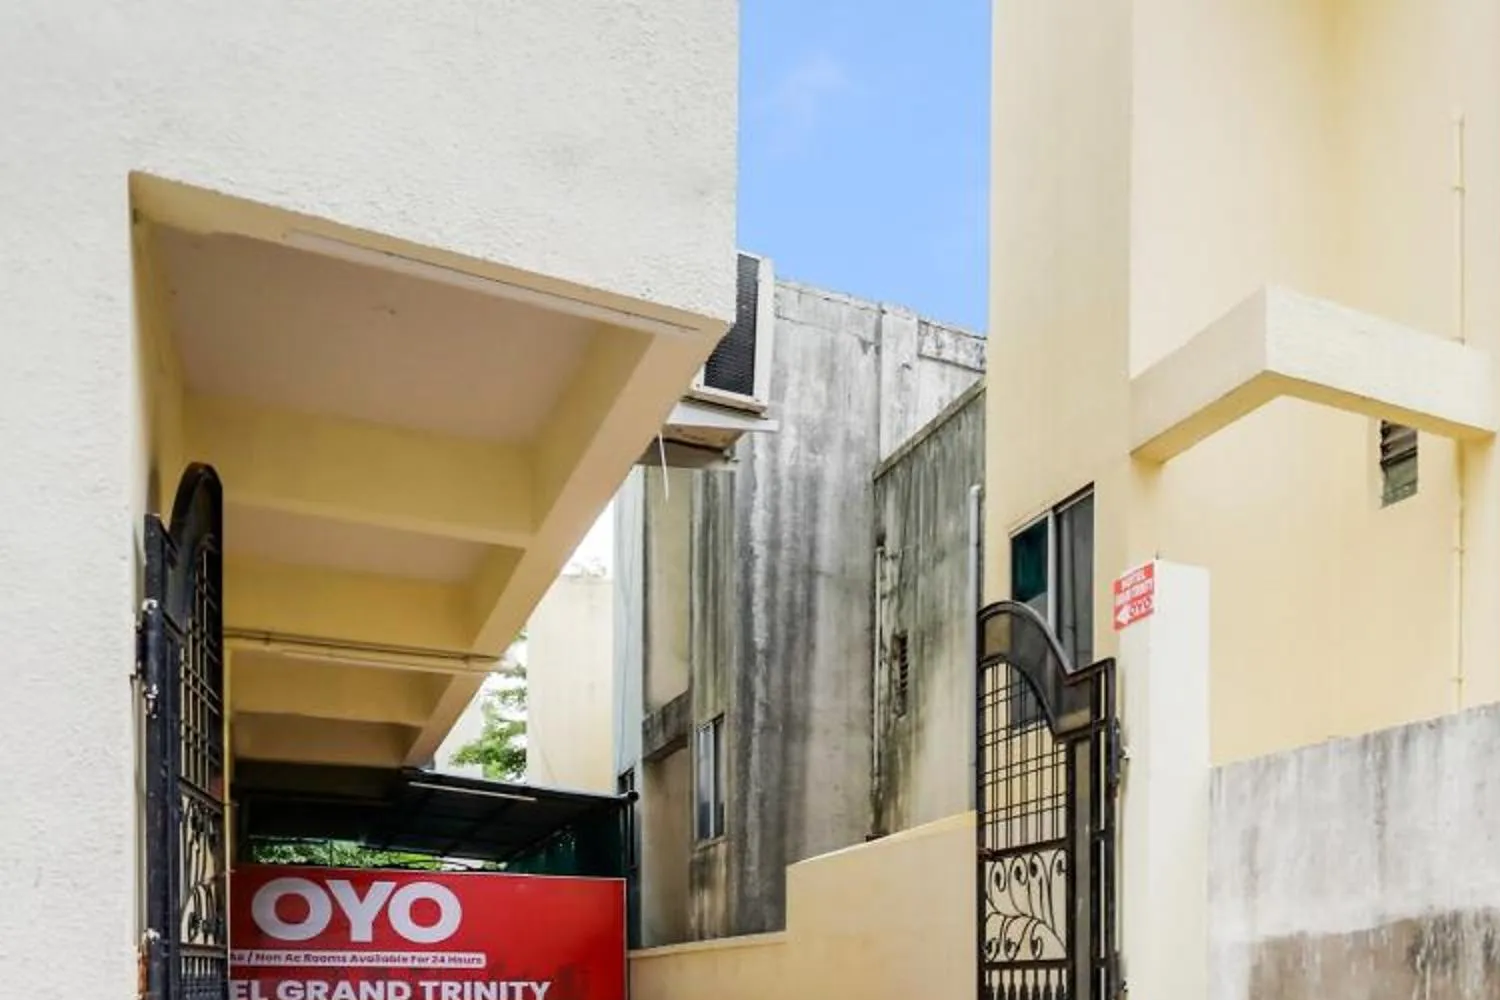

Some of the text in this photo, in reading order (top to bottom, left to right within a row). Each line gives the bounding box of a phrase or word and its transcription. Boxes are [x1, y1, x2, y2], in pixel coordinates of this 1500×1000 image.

[251, 876, 463, 944] OYO
[304, 953, 348, 964] Rooms
[350, 954, 409, 966] Available
